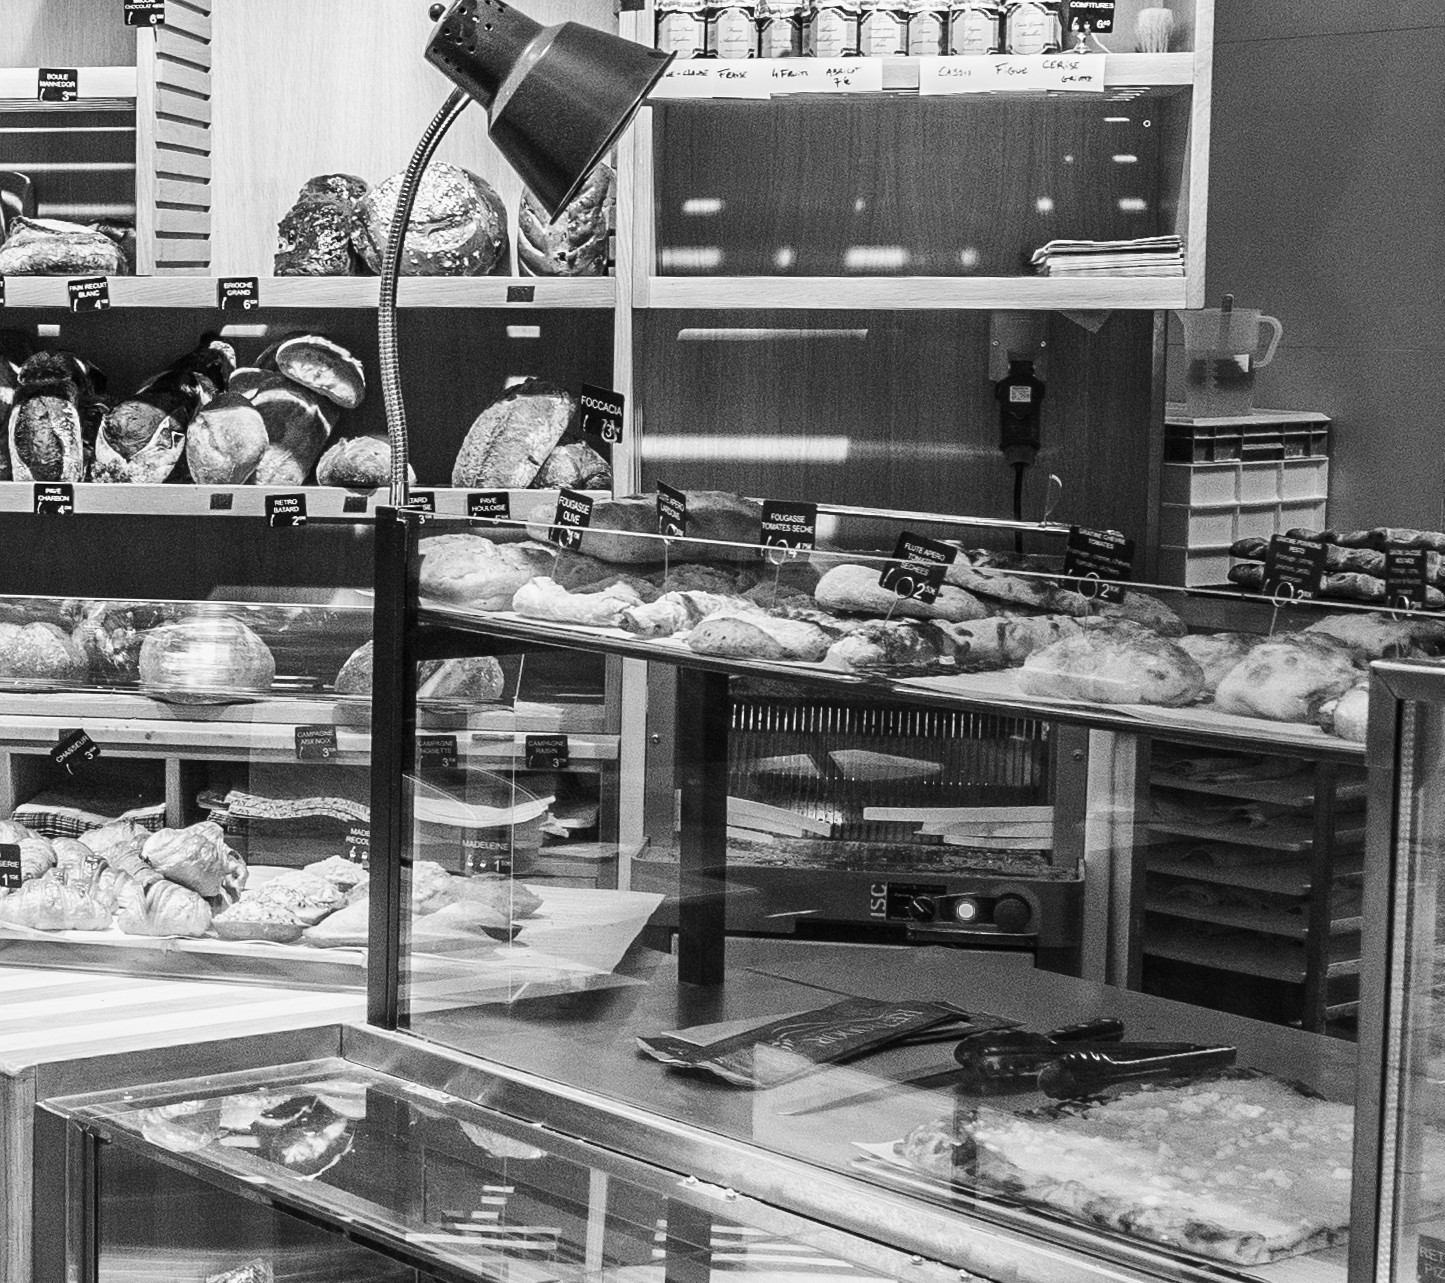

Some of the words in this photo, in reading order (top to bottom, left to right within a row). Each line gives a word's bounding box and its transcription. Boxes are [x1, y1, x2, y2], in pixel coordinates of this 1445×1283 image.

[580, 394, 623, 418] FOCCACIA
[274, 498, 298, 506] RETRO
[770, 513, 806, 524] FOUGASSE
[904, 542, 923, 555] FLUTE
[923, 548, 946, 562] APERO
[55, 734, 90, 763] CHASSEUR
[461, 838, 509, 851] MADELEINE
